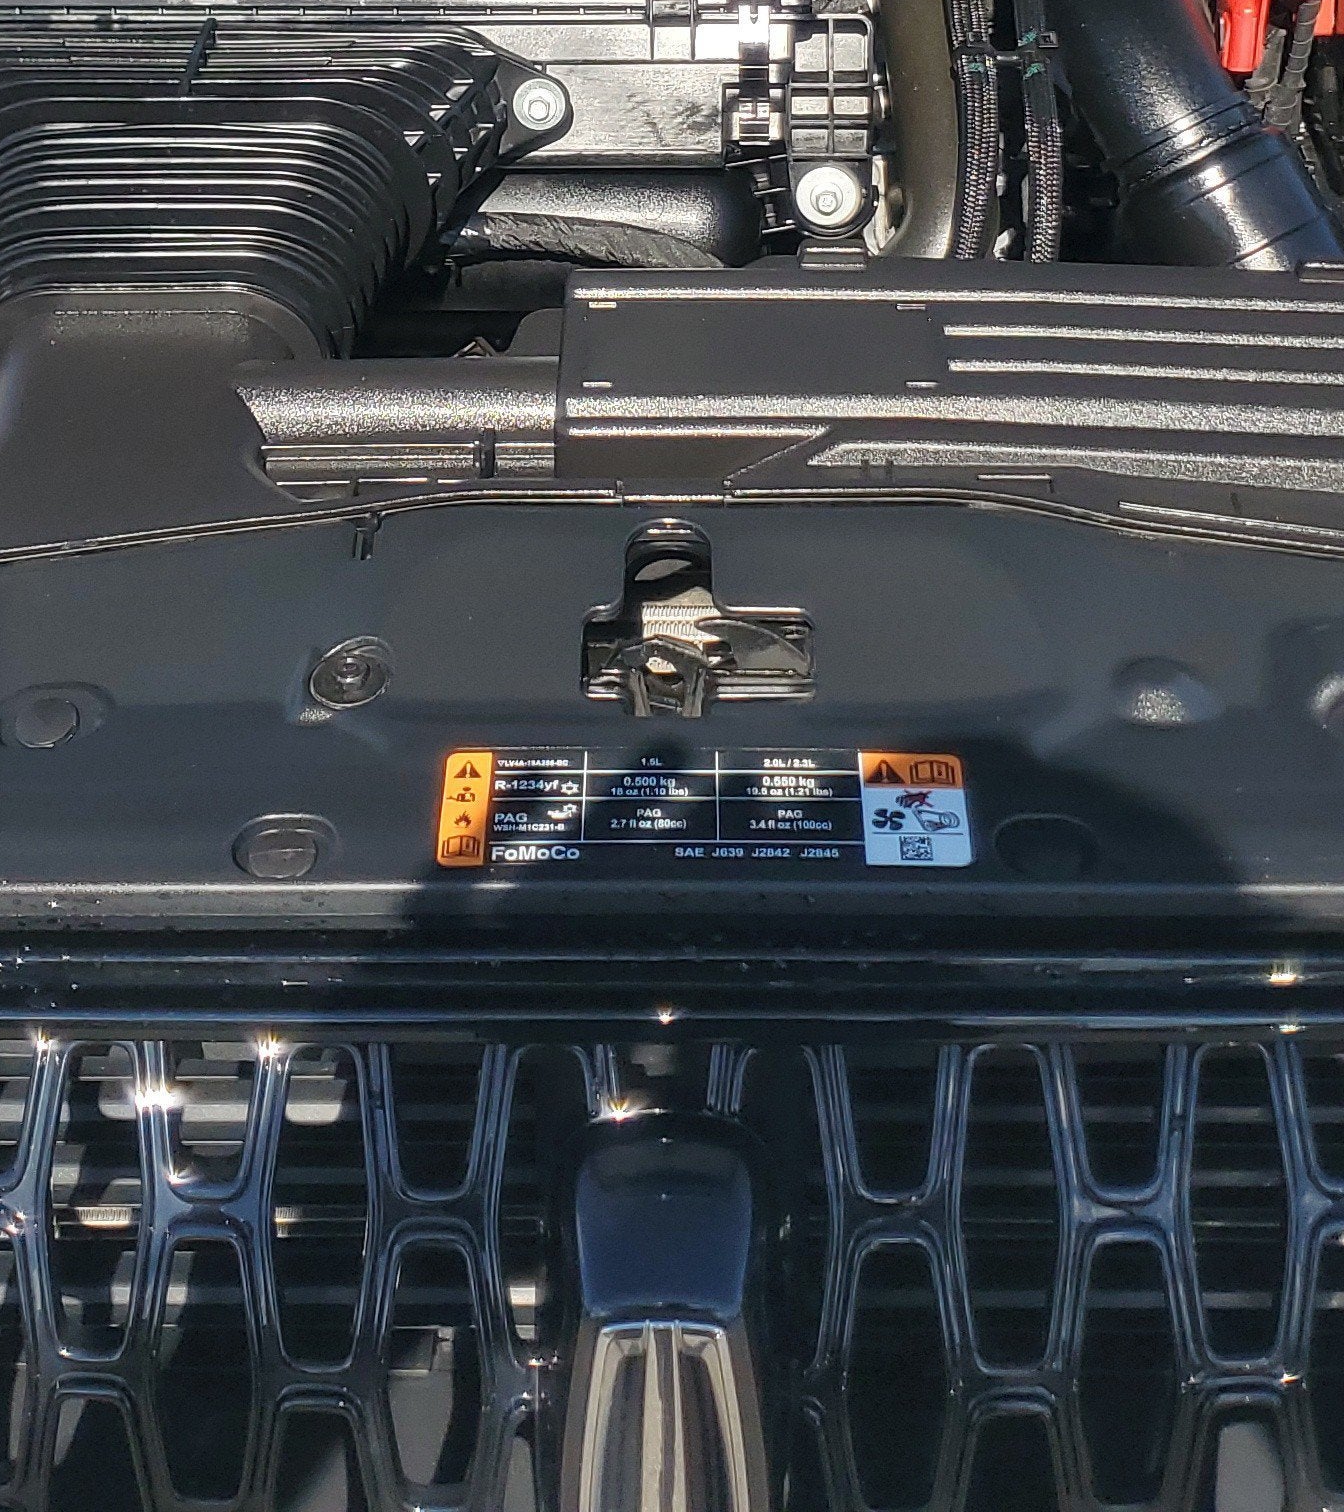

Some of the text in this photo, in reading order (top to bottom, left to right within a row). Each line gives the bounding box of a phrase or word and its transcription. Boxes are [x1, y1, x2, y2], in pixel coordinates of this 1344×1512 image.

[763, 758, 786, 768] 2.0L
[494, 779, 559, 792] R-1234yf
[623, 776, 676, 788] 0.500 kg
[798, 776, 815, 788] kg
[494, 812, 528, 823] PAG
[636, 808, 662, 818] PAG
[777, 809, 803, 819] PAG
[610, 819, 627, 828] 2.7
[638, 820, 653, 828] oz
[653, 818, 687, 830] (80cc)
[749, 819, 768, 829] 3.4
[777, 821, 791, 829] oz
[793, 820, 833, 831] (100cc)
[491, 845, 580, 862] FoMoCo
[675, 847, 705, 858] SAE
[711, 847, 744, 858] J639
[751, 847, 791, 858] J2842
